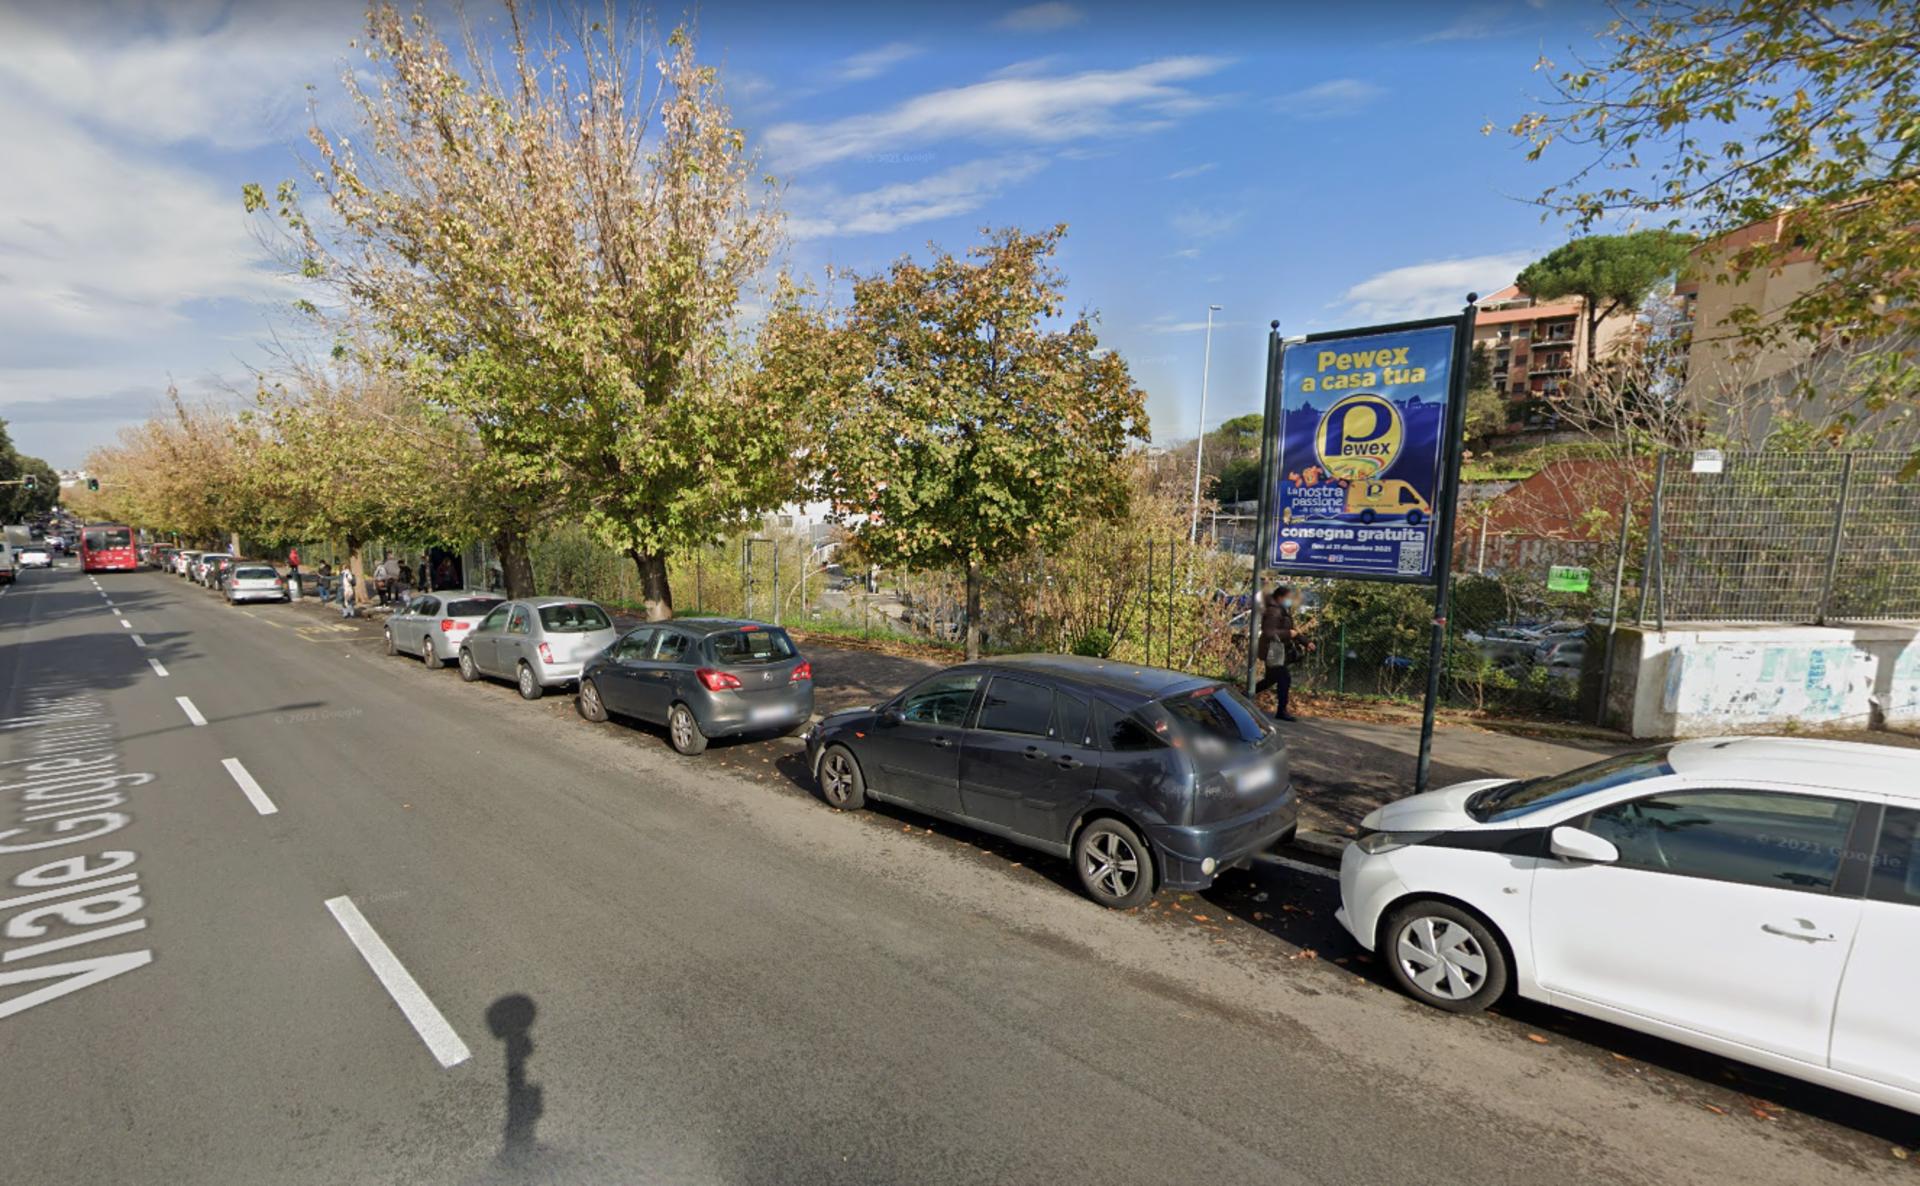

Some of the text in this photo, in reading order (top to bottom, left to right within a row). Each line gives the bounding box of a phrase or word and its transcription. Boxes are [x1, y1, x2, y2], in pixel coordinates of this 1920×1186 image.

[1317, 346, 1410, 373] Pewex
[1301, 366, 1426, 392] a casa tua
[1324, 400, 1393, 457] Pewex
[1298, 485, 1344, 498] nostra
[1291, 496, 1344, 509] passione
[1280, 527, 1426, 541] consegna gratuita
